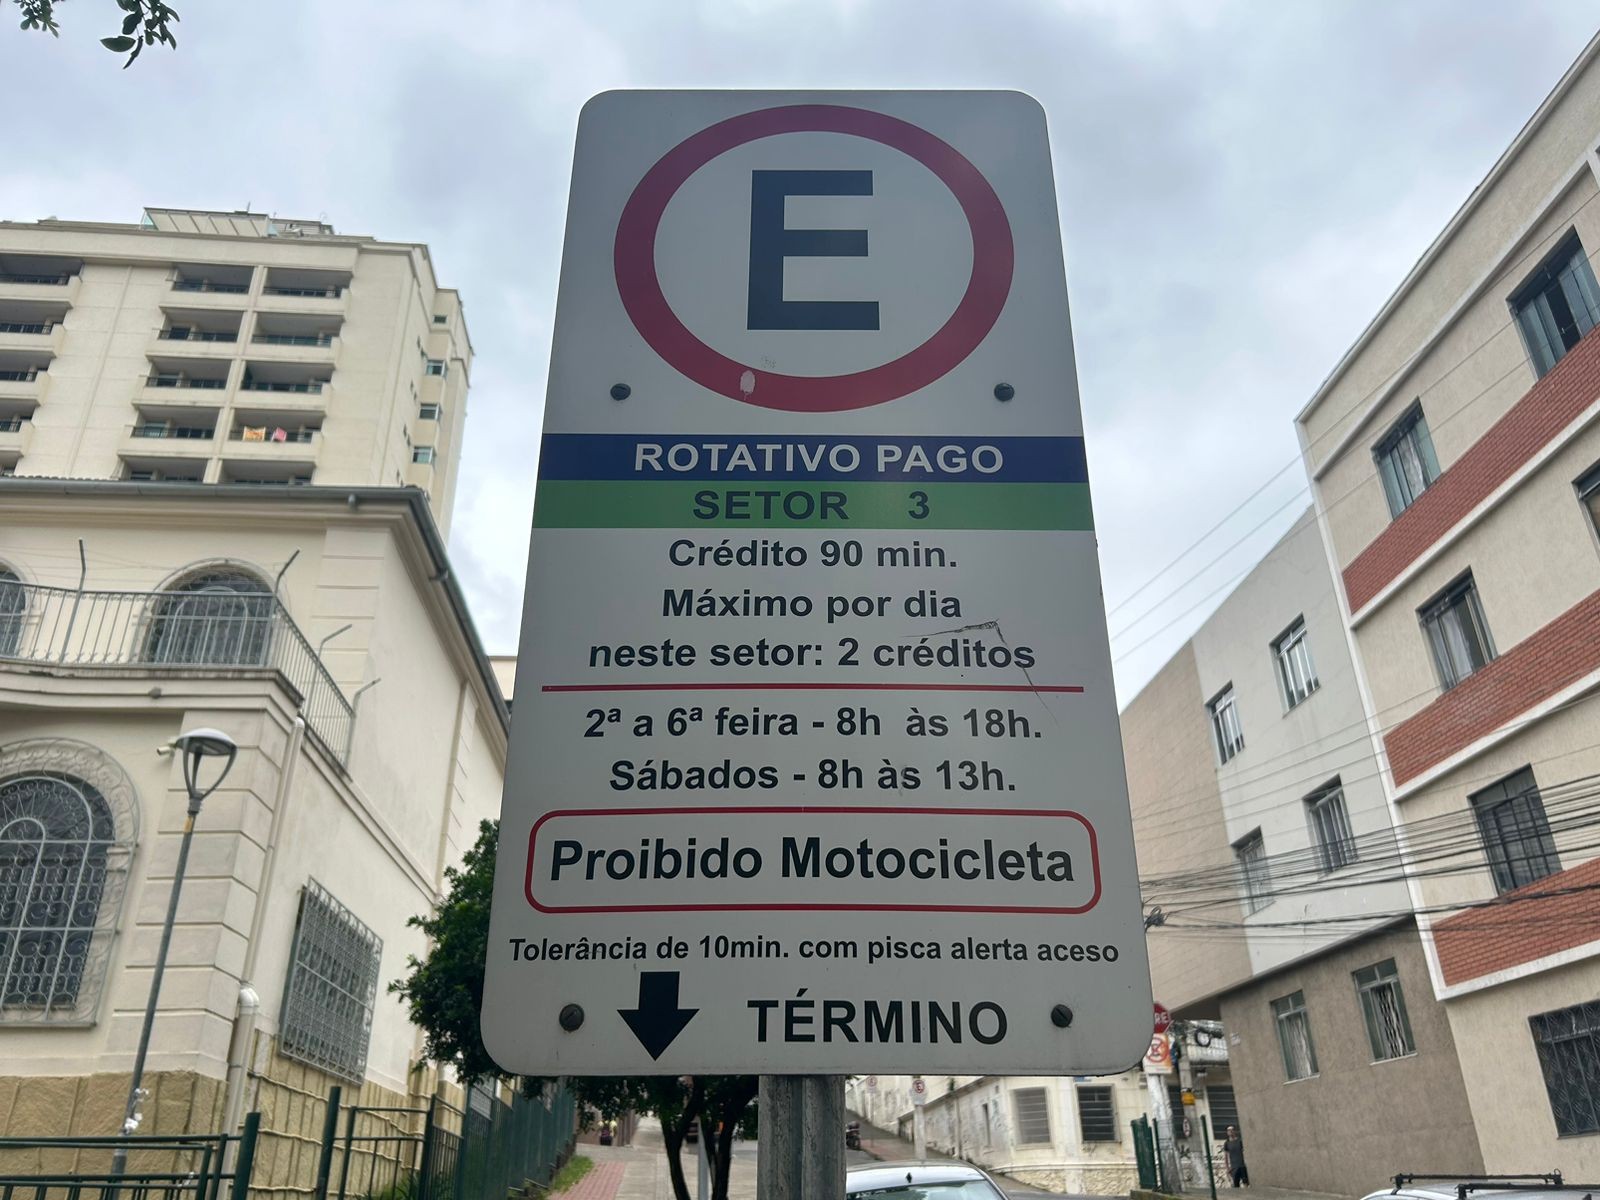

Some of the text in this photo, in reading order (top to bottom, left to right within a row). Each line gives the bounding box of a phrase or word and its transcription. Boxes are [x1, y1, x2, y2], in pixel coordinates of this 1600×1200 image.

[746, 169, 881, 331] E
[635, 443, 1004, 475] ROTATIVO PAGO
[692, 490, 931, 520] SETOR 3
[668, 538, 958, 568] Crédito 90 min.
[662, 588, 962, 624] Máximo por dia
[588, 636, 1036, 669] neste setor: 2 créditos
[583, 706, 1043, 739] 2ª a 6ª feira - 8h às 18h.
[609, 758, 1017, 792] Sábados - 8h às 13h.
[550, 836, 1075, 882] Proibido Motocicleta
[508, 934, 1120, 965] Tolerância de 10min. com pisca alerta aceso
[746, 987, 1009, 1046] TÉRMINO
